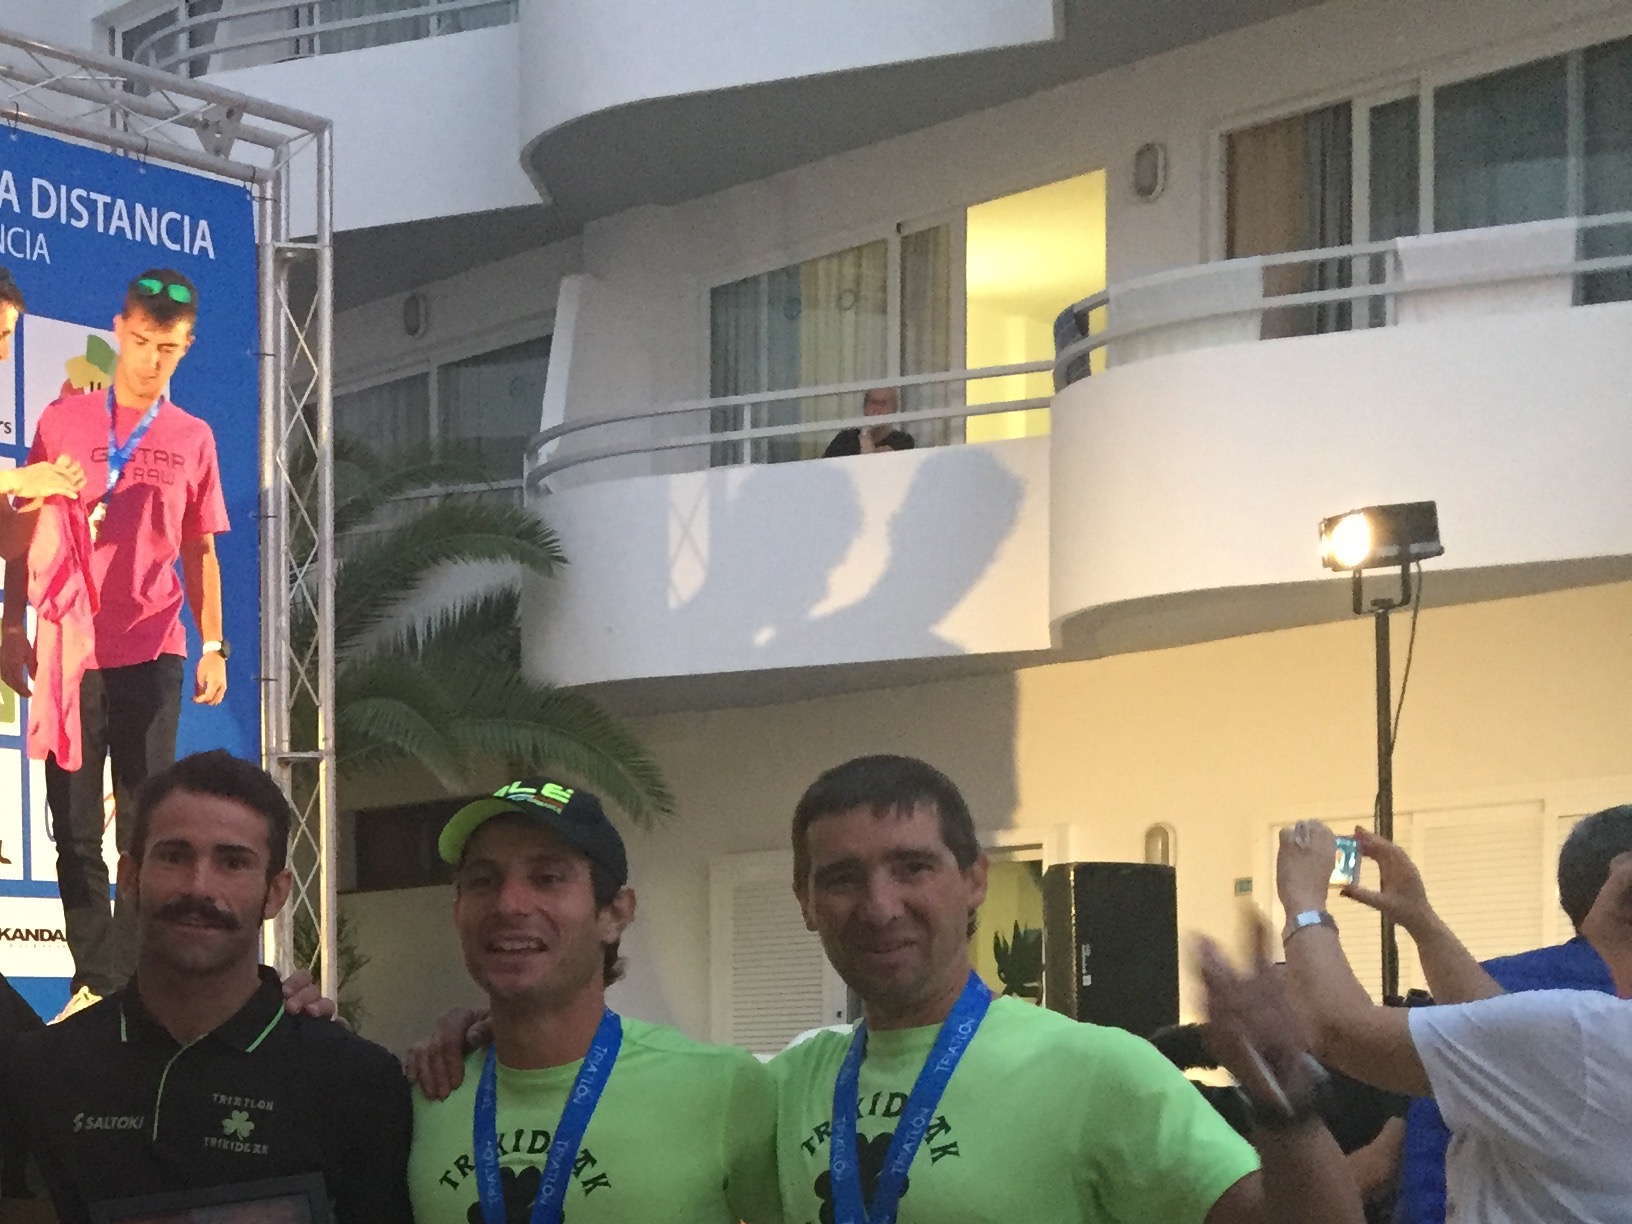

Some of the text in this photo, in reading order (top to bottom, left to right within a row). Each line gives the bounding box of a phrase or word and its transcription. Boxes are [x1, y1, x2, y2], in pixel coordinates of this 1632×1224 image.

[31, 177, 215, 260] DISTANCIA
[134, 467, 174, 486] RAW
[85, 1115, 145, 1131] SALTOKI
